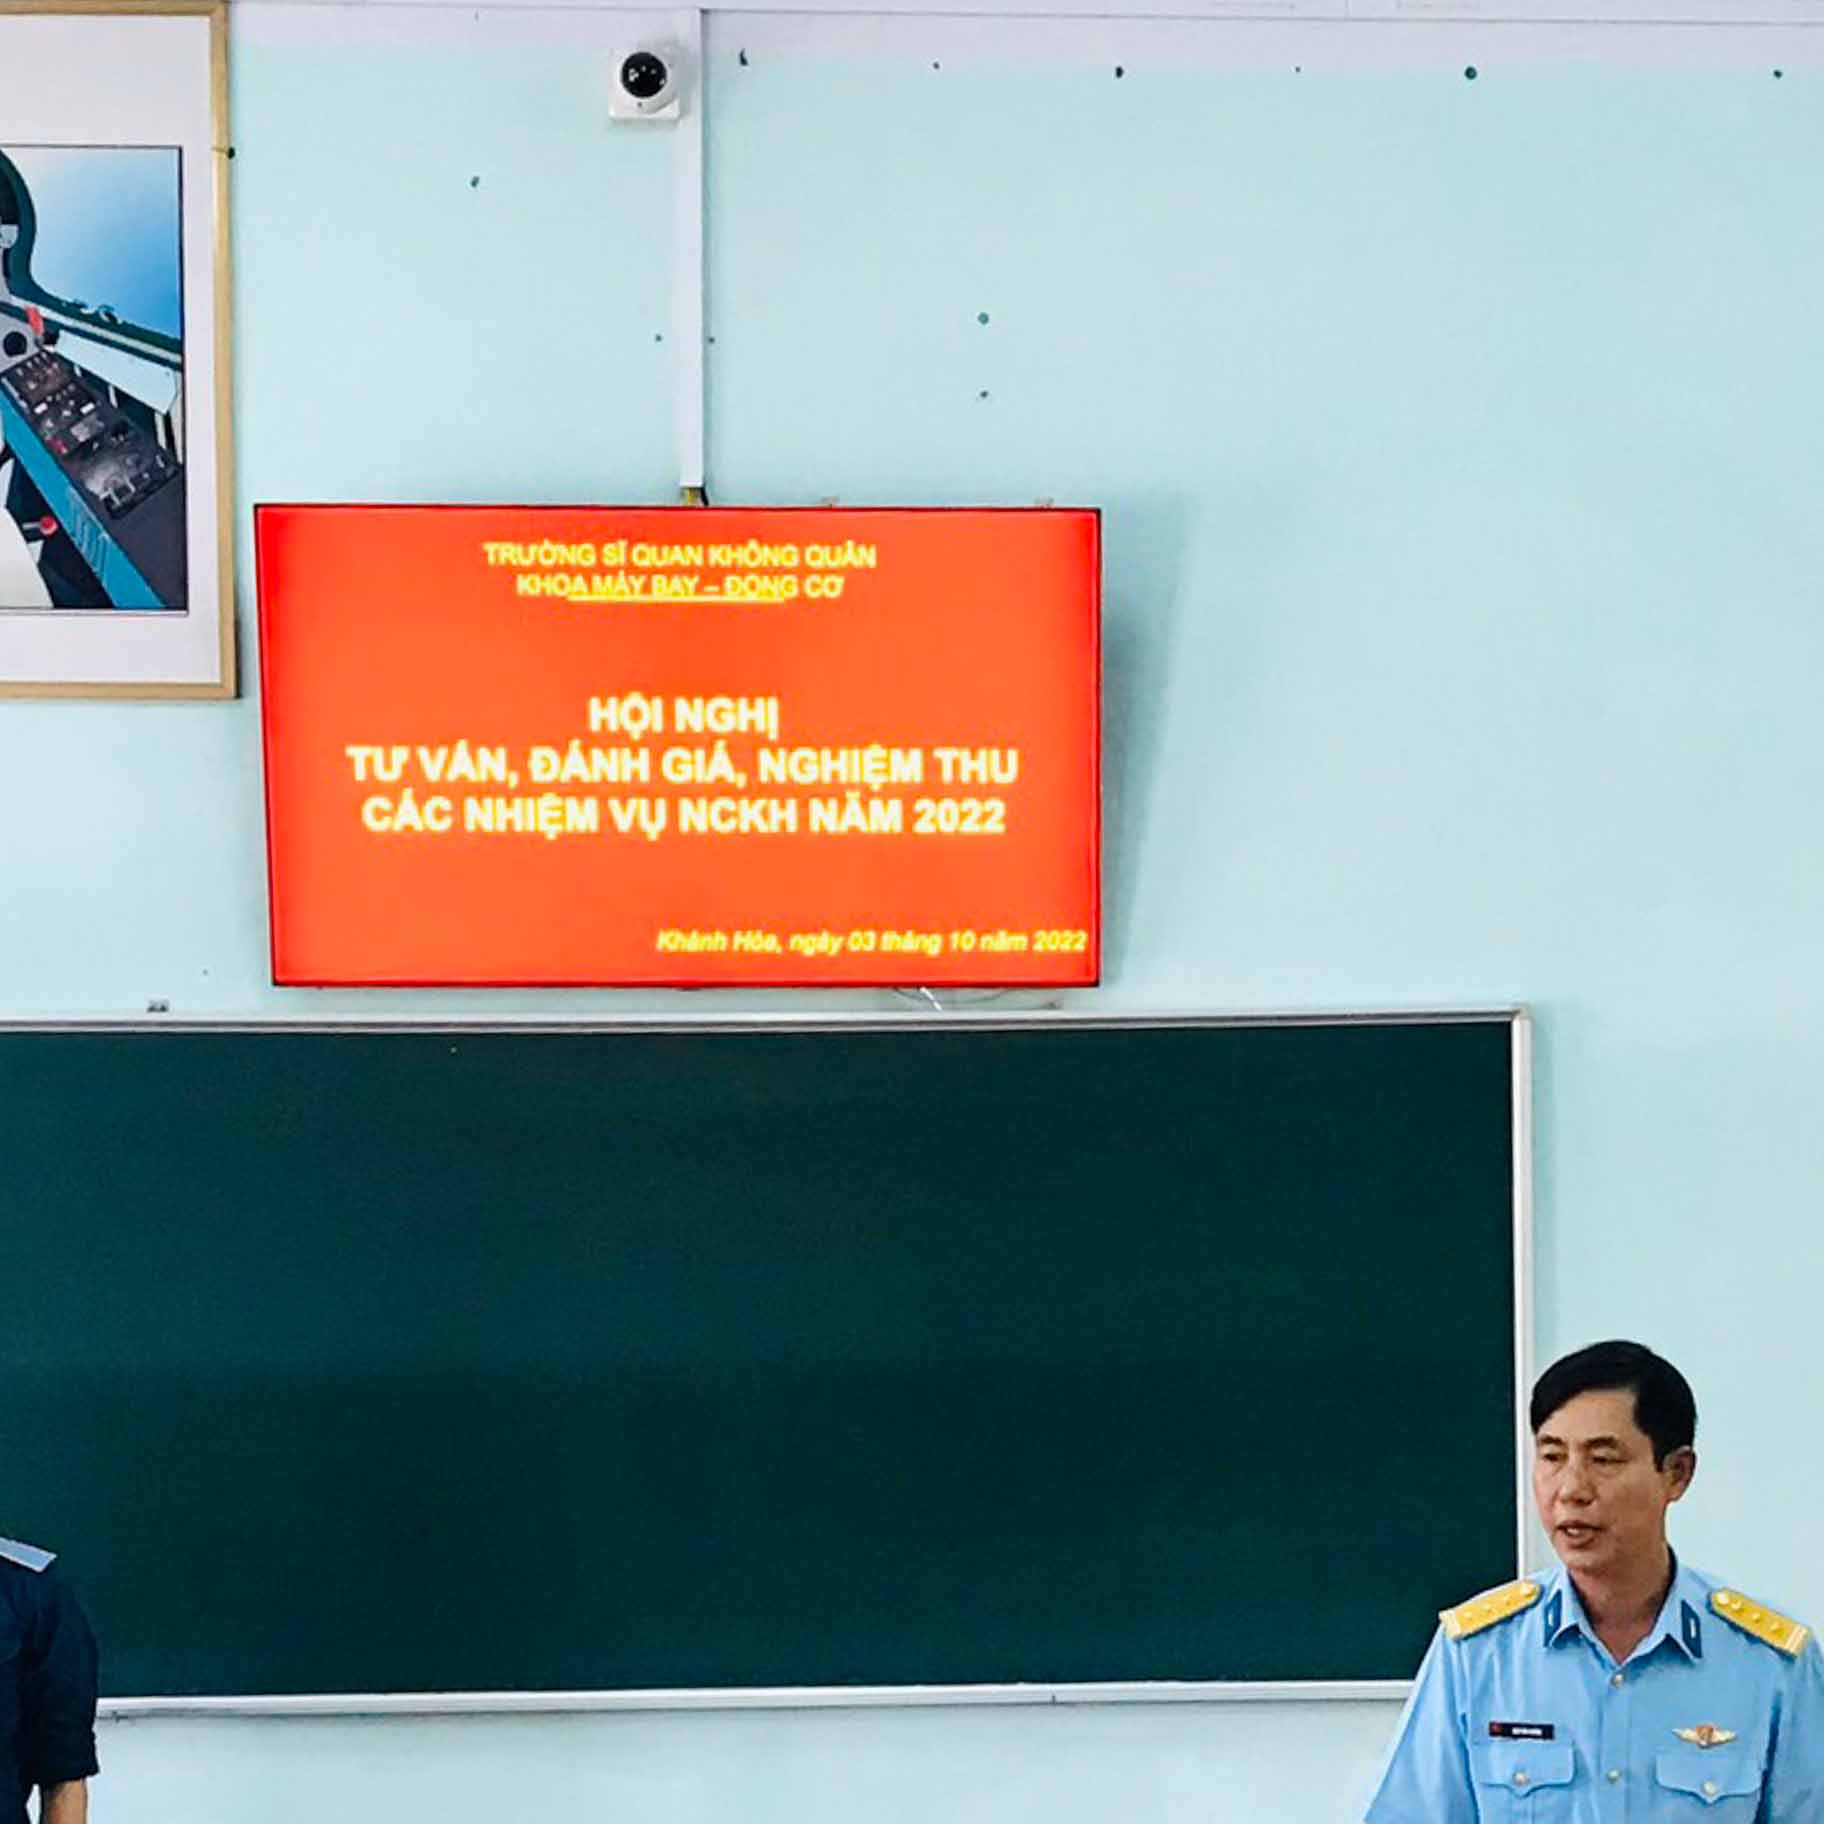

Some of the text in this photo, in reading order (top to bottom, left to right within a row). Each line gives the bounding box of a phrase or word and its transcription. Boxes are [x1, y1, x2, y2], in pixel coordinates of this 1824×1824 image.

[482, 539, 596, 567] TRƯỜNG
[632, 543, 704, 567] QUAN
[708, 538, 800, 568] KHÔNG
[805, 539, 877, 568] QUÂN
[516, 573, 589, 597] KHOA
[592, 569, 647, 597] MÁY
[651, 574, 699, 598] BAY
[588, 692, 778, 741] HỘI NGHỊ
[345, 745, 409, 781] TƯ
[528, 738, 650, 783] ĐÁNH
[661, 739, 747, 789] GIÁ,
[758, 743, 923, 791] NGHIỆM
[933, 748, 1019, 784] THU
[362, 788, 1007, 841] CÁC NHIỆM VỤ NCKH NĂM 2022
[950, 930, 976, 951] 10
[1032, 930, 1087, 952] 2022
